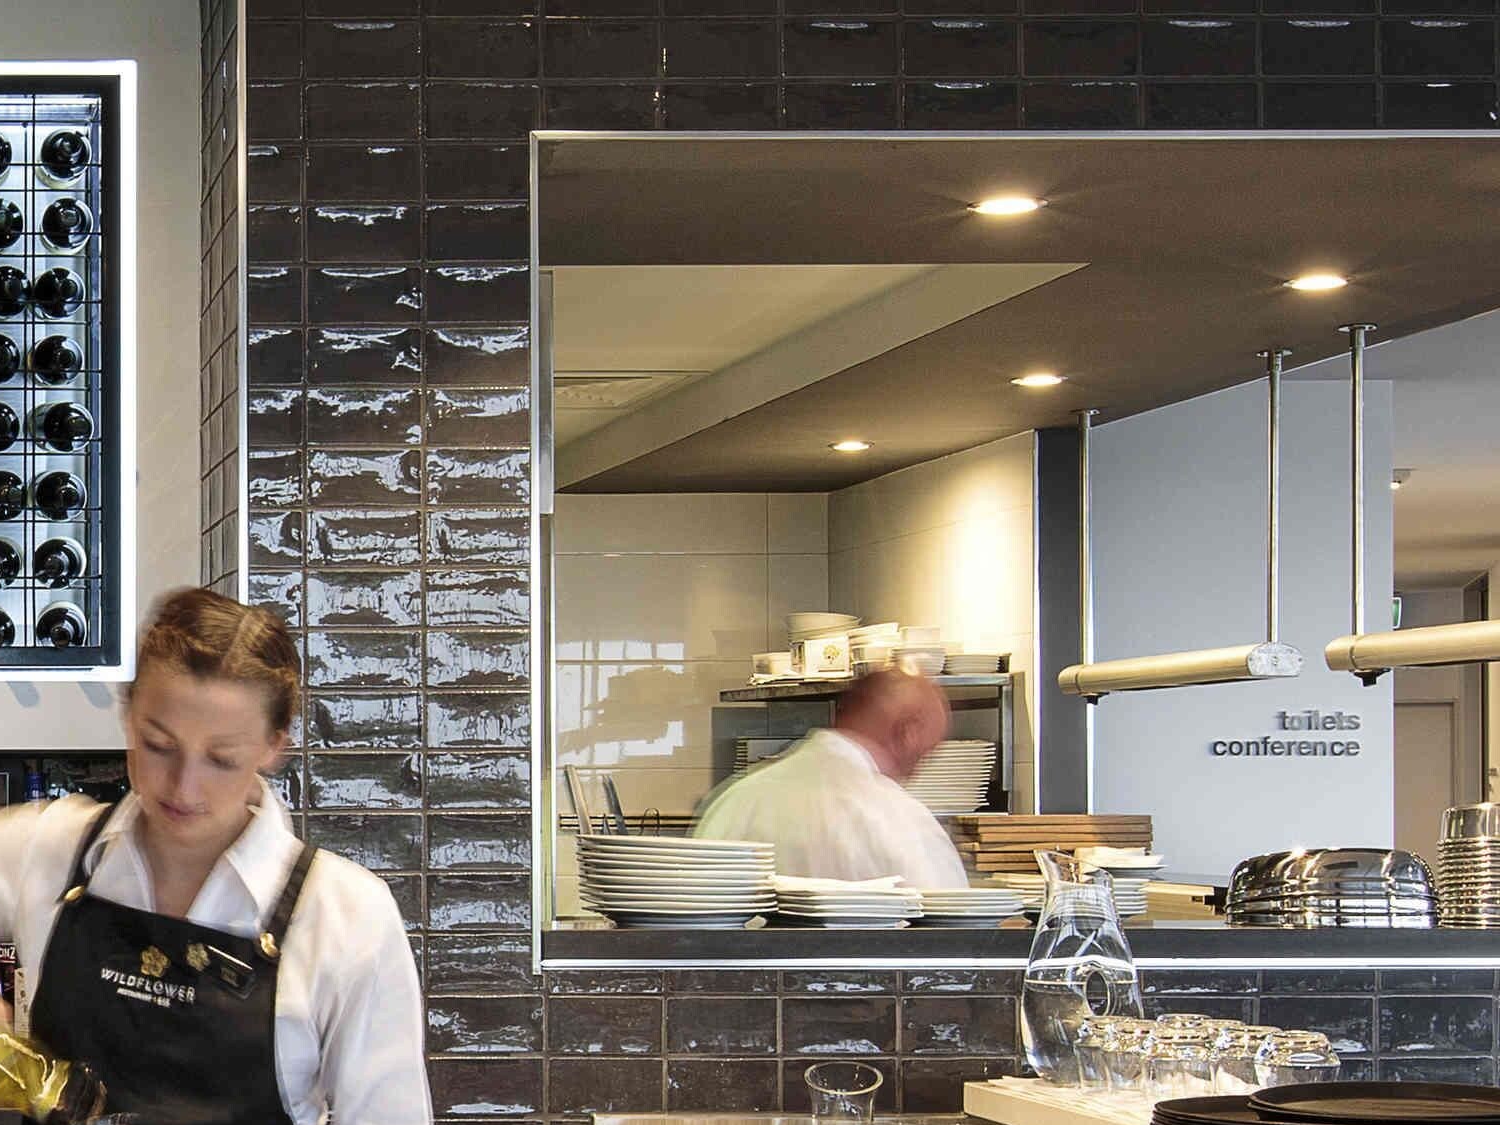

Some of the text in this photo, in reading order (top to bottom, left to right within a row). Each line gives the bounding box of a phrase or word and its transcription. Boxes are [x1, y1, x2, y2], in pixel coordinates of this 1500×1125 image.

[1275, 710, 1361, 730] toilets
[1210, 737, 1361, 756] conference
[101, 967, 195, 1005] WILDFLOWER
